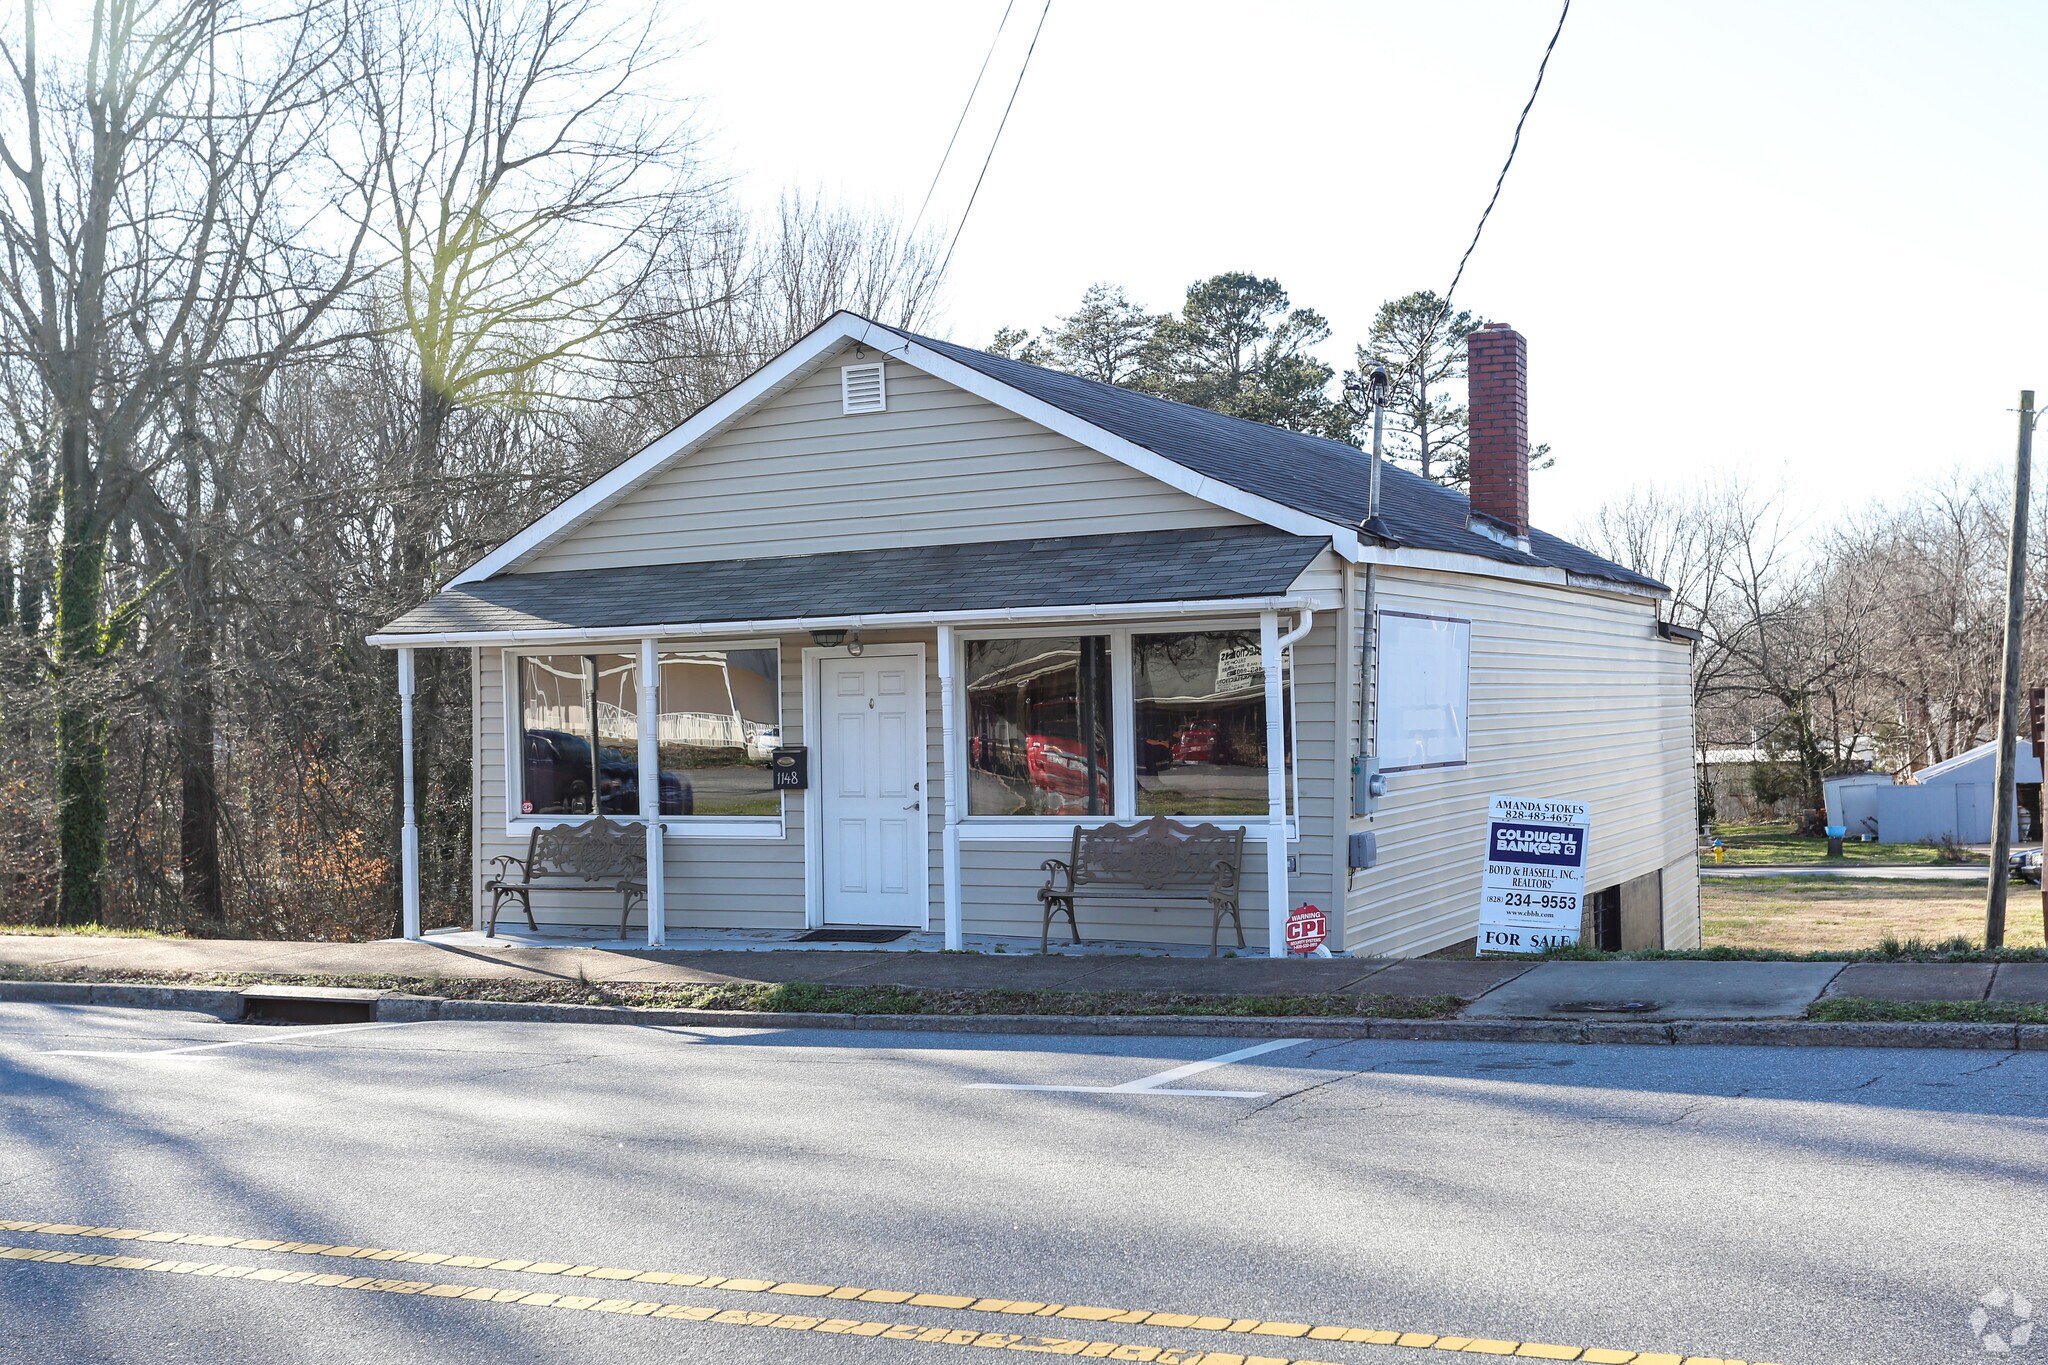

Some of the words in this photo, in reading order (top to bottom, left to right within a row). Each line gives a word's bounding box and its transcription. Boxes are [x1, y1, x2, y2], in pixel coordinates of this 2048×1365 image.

[777, 771, 799, 785] 1148
[1496, 800, 1541, 811] AMANDA
[1543, 803, 1584, 814] STOKES
[1505, 811, 1574, 823] 828-485-4657
[1496, 828, 1578, 844] COLDWELL
[1496, 840, 1561, 856] BANKER
[1489, 864, 1511, 875] BOYD
[1513, 867, 1521, 876] &
[1522, 867, 1558, 880] HASSELL,
[1486, 895, 1504, 903] (828)
[1505, 892, 1577, 910] 234-9553
[1292, 912, 1320, 922] WARNING
[1288, 920, 1324, 939] CPI
[1485, 931, 1521, 946] FOR
[1530, 934, 1570, 949] SALE
